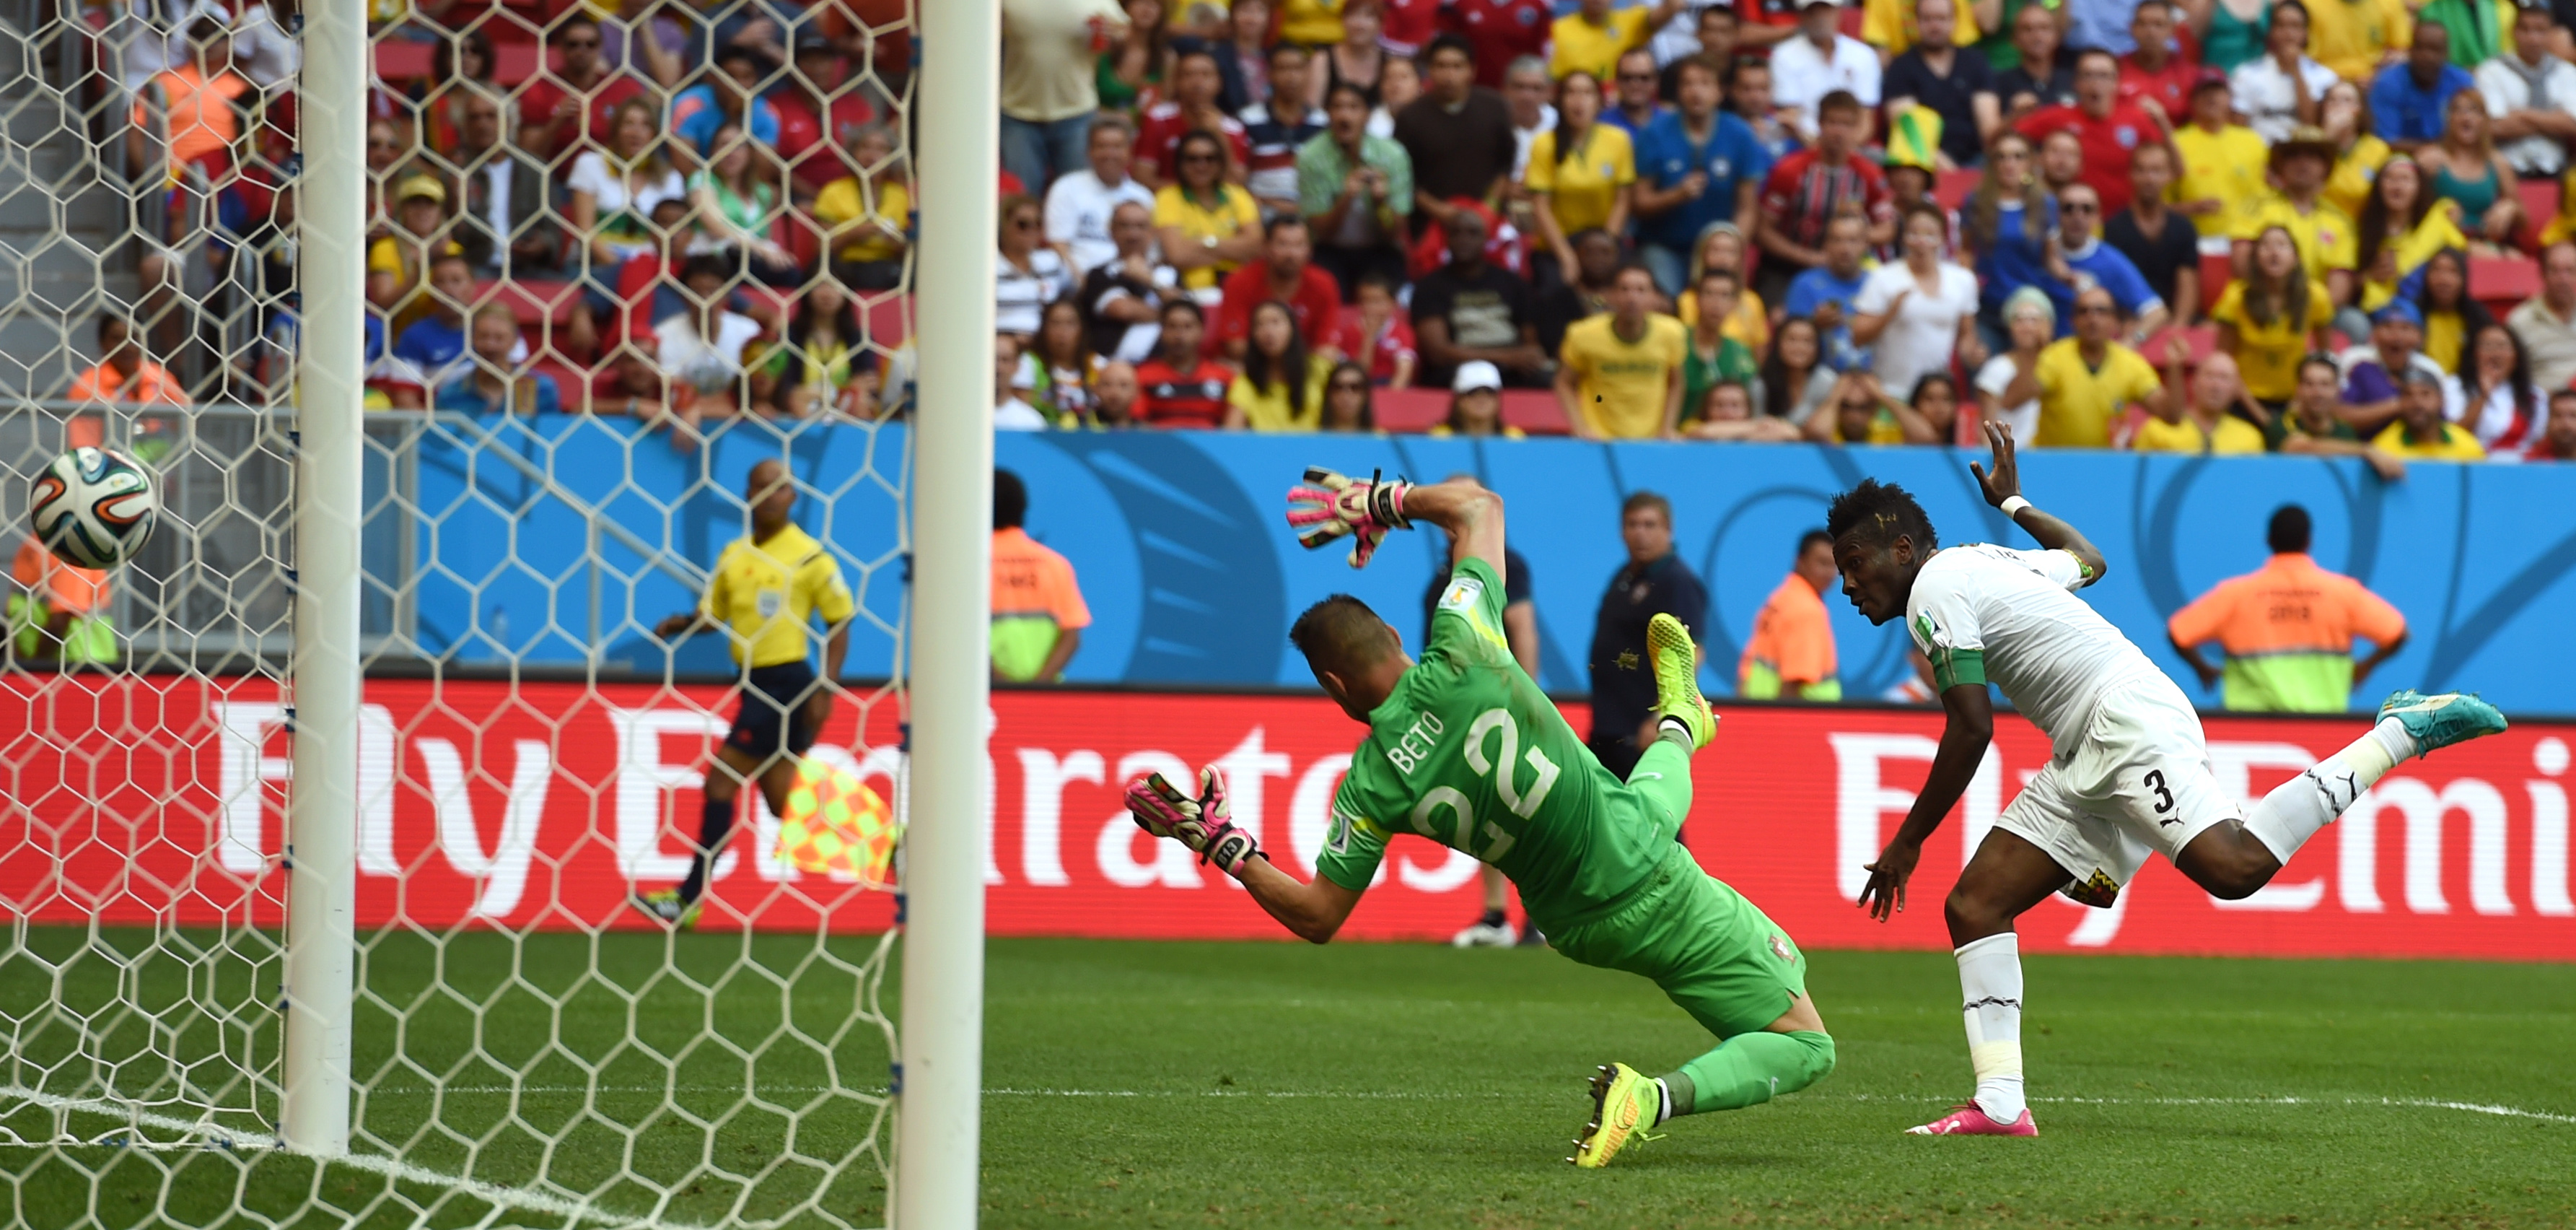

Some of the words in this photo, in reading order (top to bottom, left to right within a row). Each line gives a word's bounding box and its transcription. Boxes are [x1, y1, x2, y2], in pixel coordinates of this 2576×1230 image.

[211, 701, 549, 917] Fly
[1387, 710, 1444, 775] BETO
[1411, 708, 1561, 863] 22
[2143, 769, 2174, 814] 3
[1828, 731, 2132, 947] Fl
